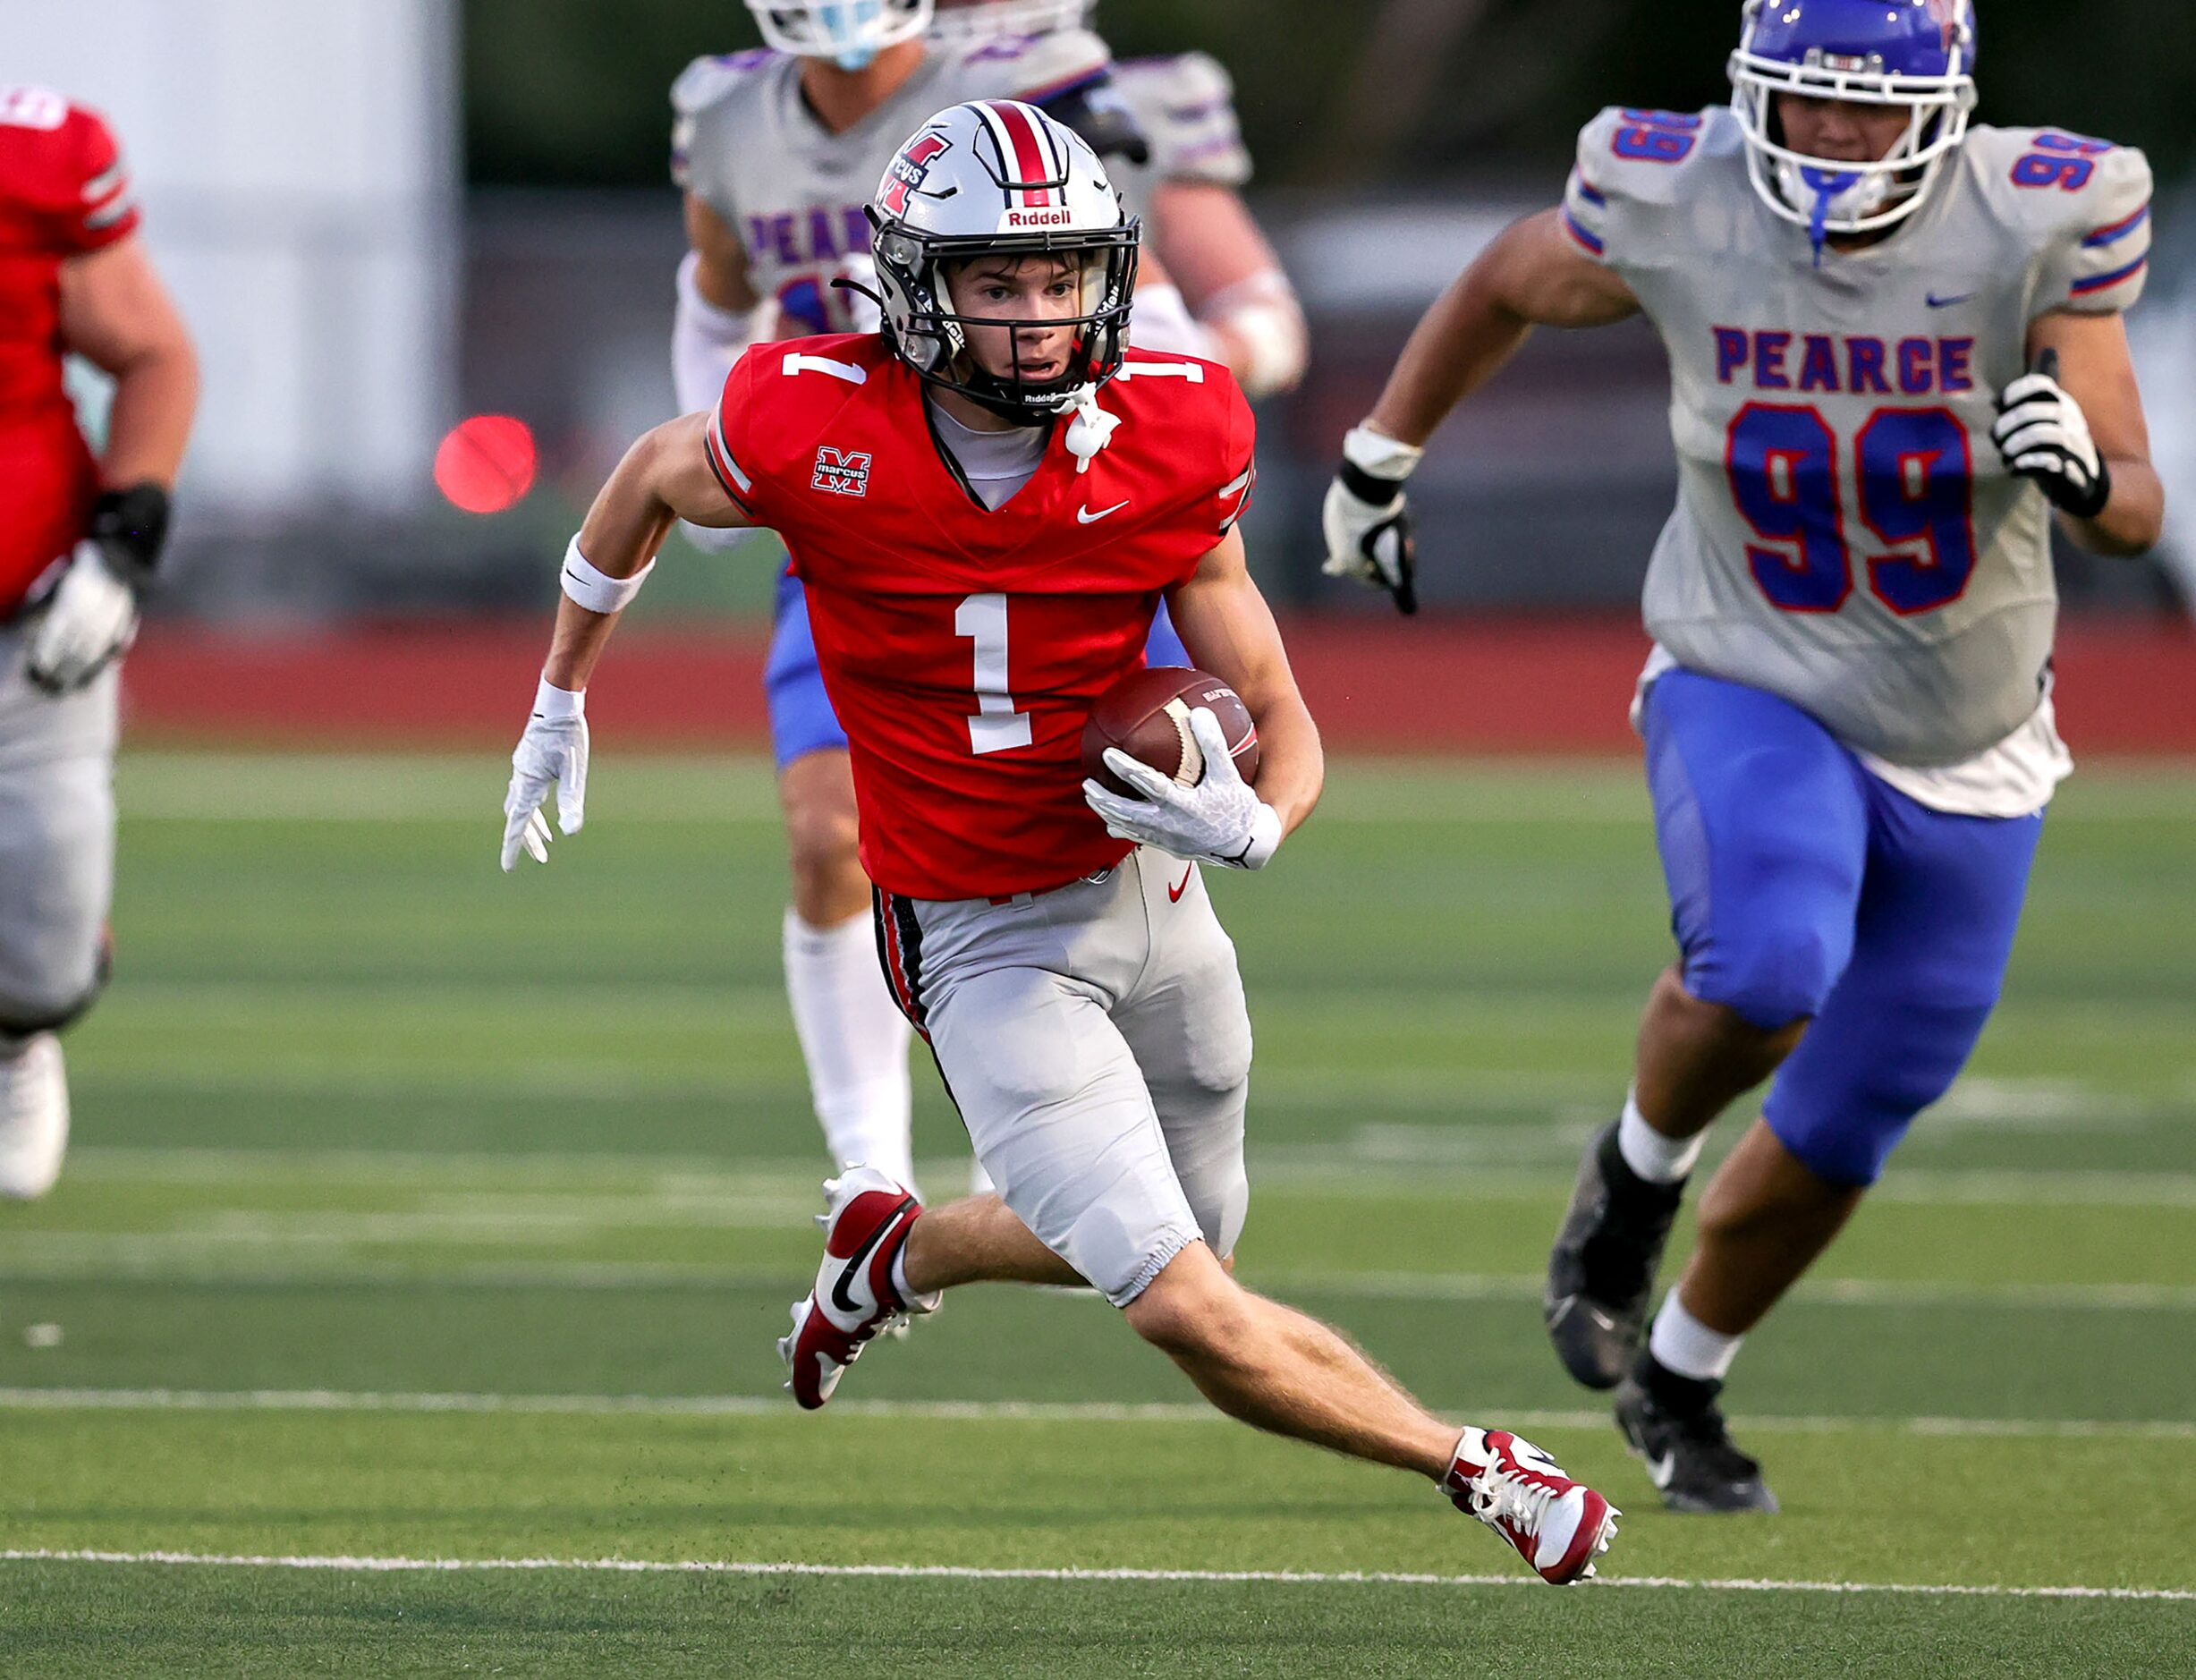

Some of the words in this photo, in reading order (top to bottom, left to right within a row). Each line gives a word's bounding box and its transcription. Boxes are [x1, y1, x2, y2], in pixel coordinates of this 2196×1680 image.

[1008, 209, 1071, 226] Riddell
[783, 352, 867, 385] 1
[1118, 361, 1204, 383] 1
[1712, 324, 1975, 395] PEARCE
[810, 445, 872, 496] M
[817, 463, 866, 479] marcus
[1725, 402, 1978, 616] 99
[955, 593, 1033, 755] 1
